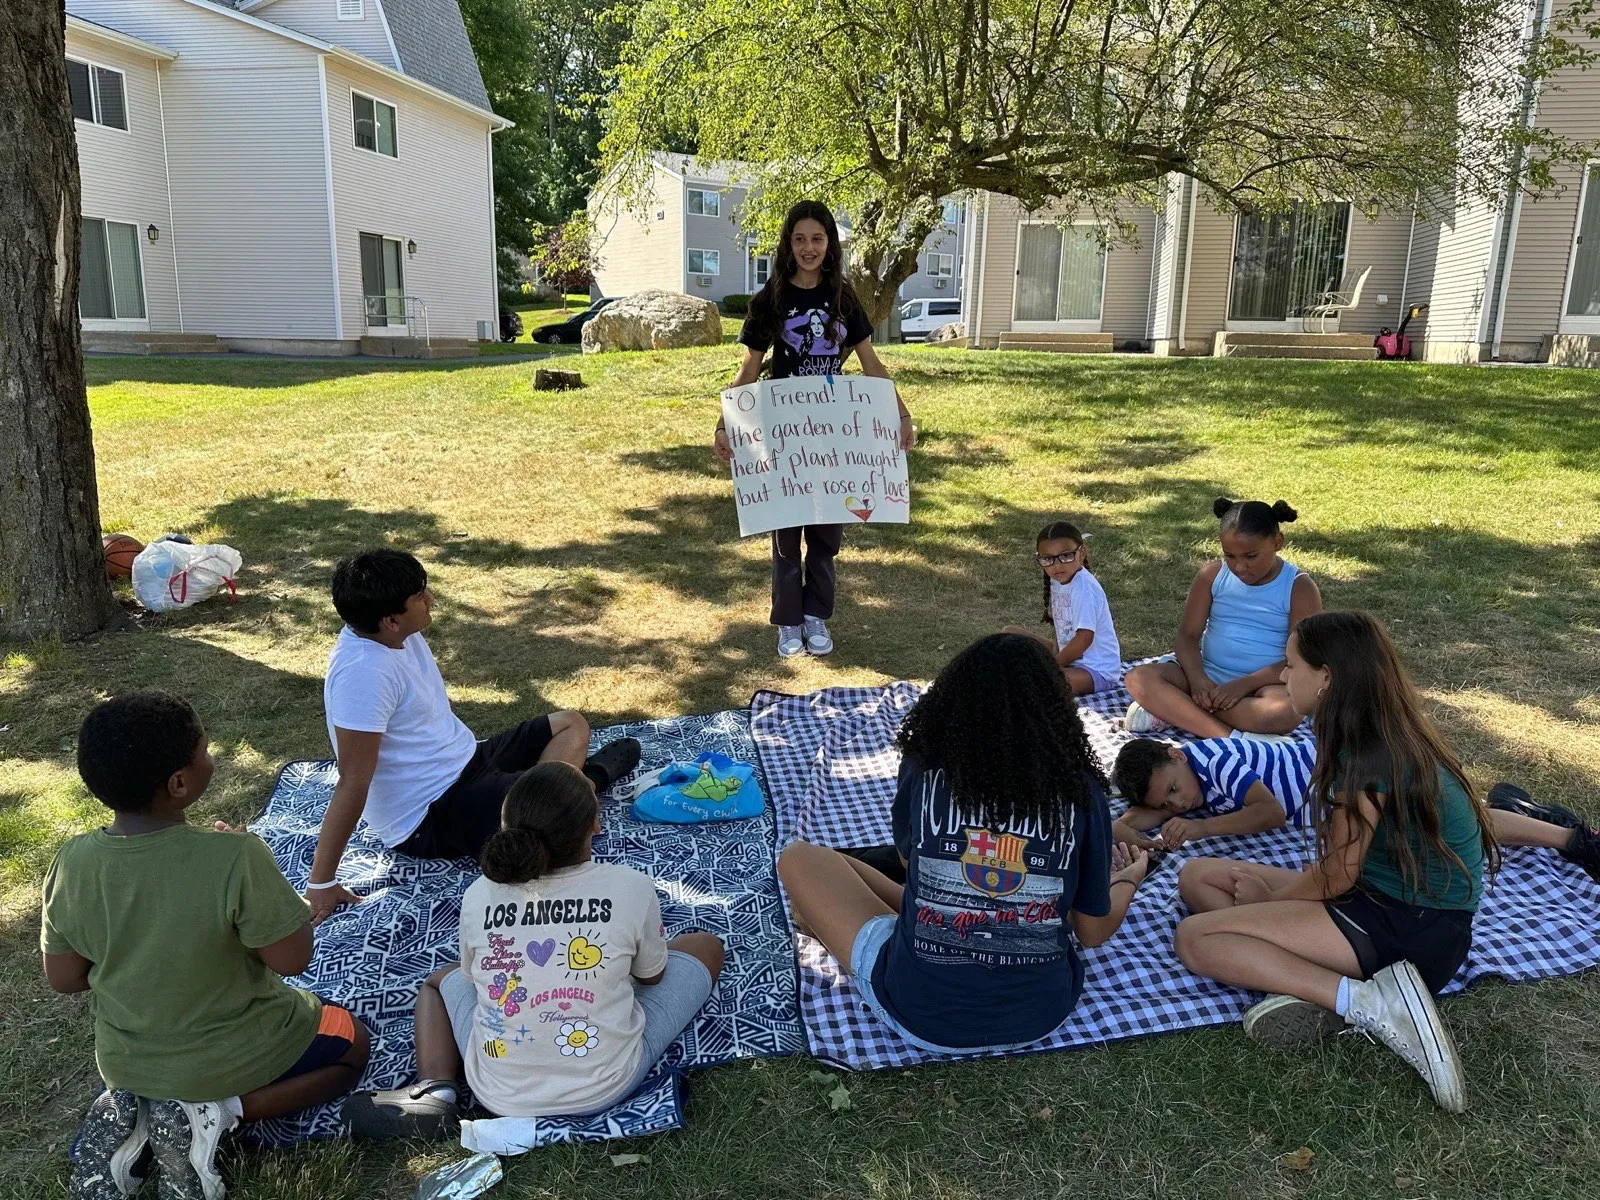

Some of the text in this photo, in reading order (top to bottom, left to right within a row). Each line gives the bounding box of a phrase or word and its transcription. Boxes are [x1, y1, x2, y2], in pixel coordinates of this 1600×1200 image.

[771, 382, 836, 407] Friend!
[842, 380, 871, 404] In
[729, 411, 900, 457] the garden of thy
[733, 446, 899, 478] heart plant naught
[737, 483, 773, 507] but
[780, 476, 814, 497] the
[823, 480, 857, 494] rose
[862, 470, 879, 493] of
[663, 794, 740, 821] For Every Child
[944, 842, 958, 852] 18
[1030, 857, 1045, 867] 99
[484, 898, 612, 930] LOS ANGELES
[951, 911, 987, 940] que
[914, 939, 945, 954] HOME
[970, 952, 994, 963] THE
[531, 986, 595, 1009] LOS ANGELES
[539, 1010, 589, 1023] Hollywood
